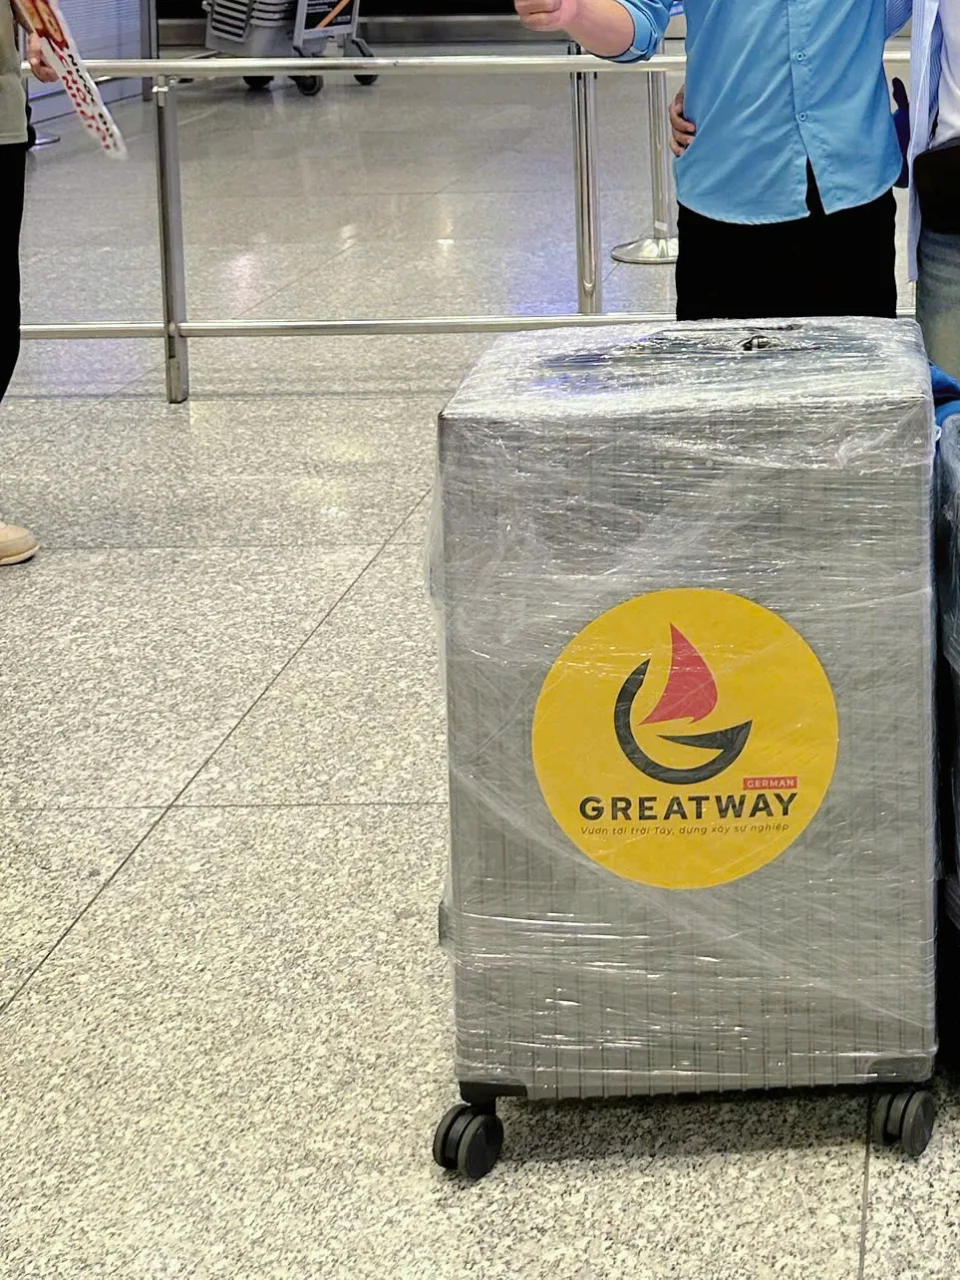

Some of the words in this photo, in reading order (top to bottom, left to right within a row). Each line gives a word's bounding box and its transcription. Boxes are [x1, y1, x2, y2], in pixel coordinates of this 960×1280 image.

[746, 778, 794, 788] GERMAN
[579, 792, 798, 820] GREATWAY
[750, 822, 789, 834] nghiệp
